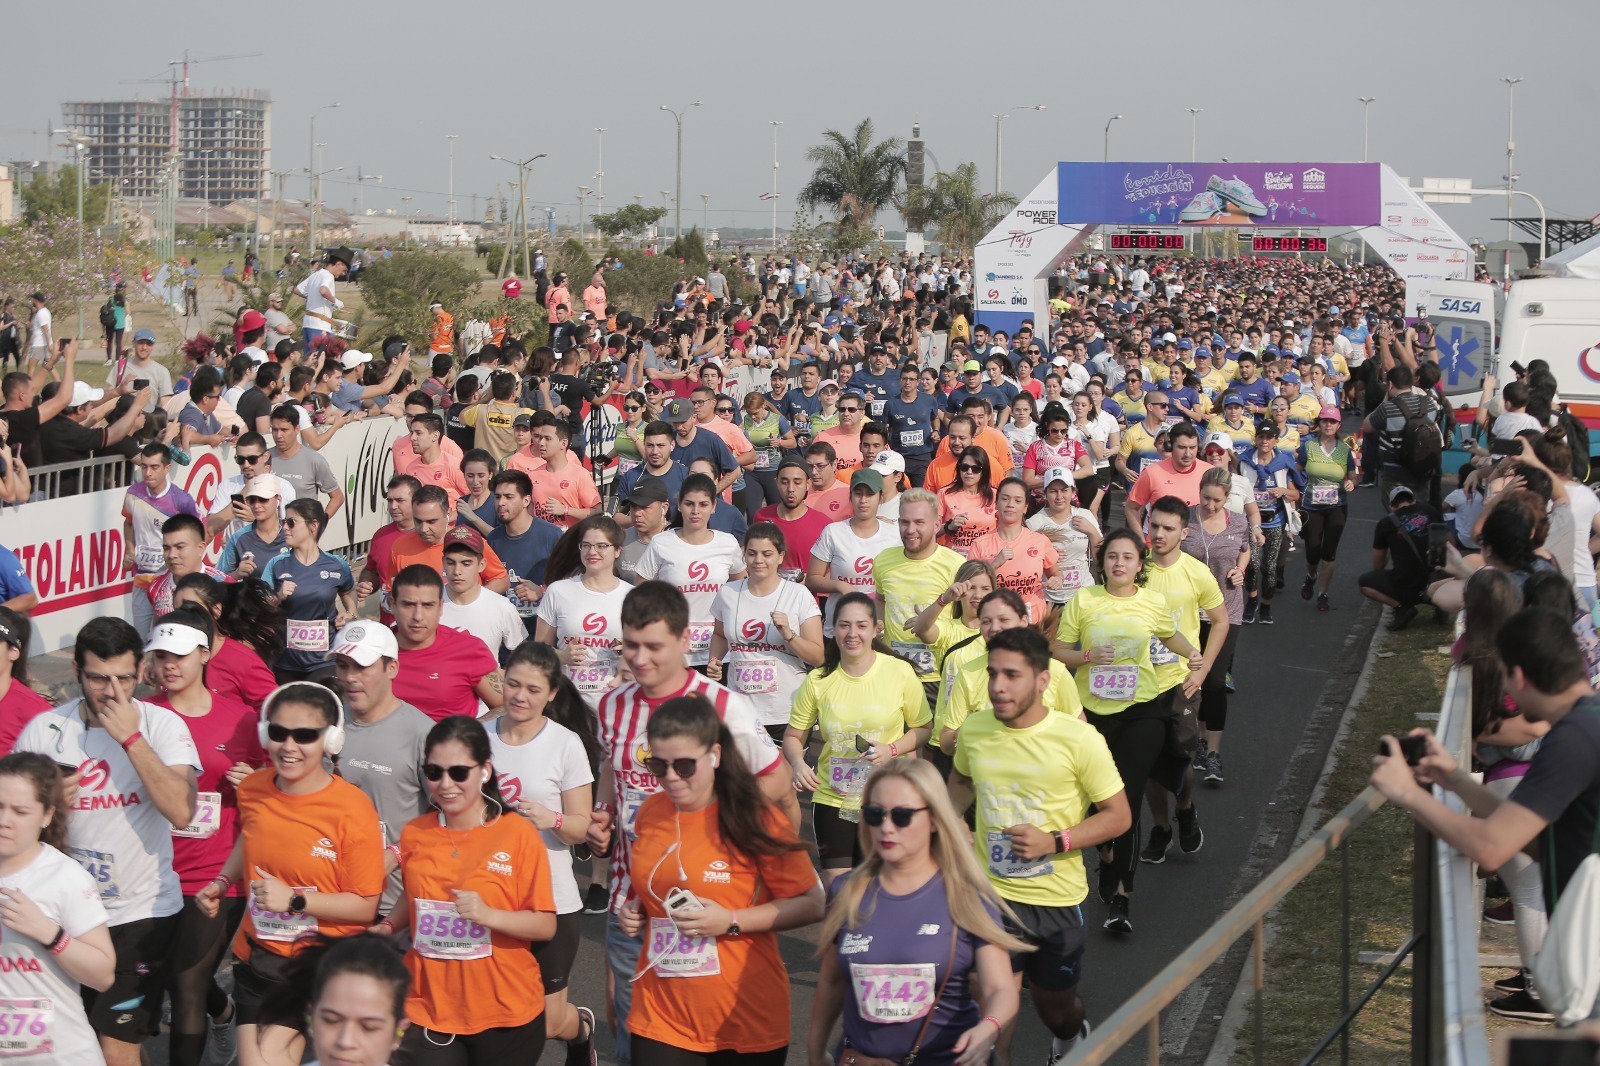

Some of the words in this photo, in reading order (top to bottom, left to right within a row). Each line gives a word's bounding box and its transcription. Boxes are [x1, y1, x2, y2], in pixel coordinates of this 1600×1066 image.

[1439, 299, 1481, 313] SASA
[902, 434, 923, 442] 8308
[838, 575, 876, 586] SALEM
[677, 583, 725, 593] ALEMM
[290, 628, 326, 641] 7032
[569, 668, 609, 682] 7687
[735, 668, 774, 682] 7688
[1093, 674, 1137, 689] 8433
[743, 684, 763, 692] SALEMMA
[418, 914, 486, 939] 8588
[653, 931, 710, 955] 8587
[859, 980, 930, 1003] 7442
